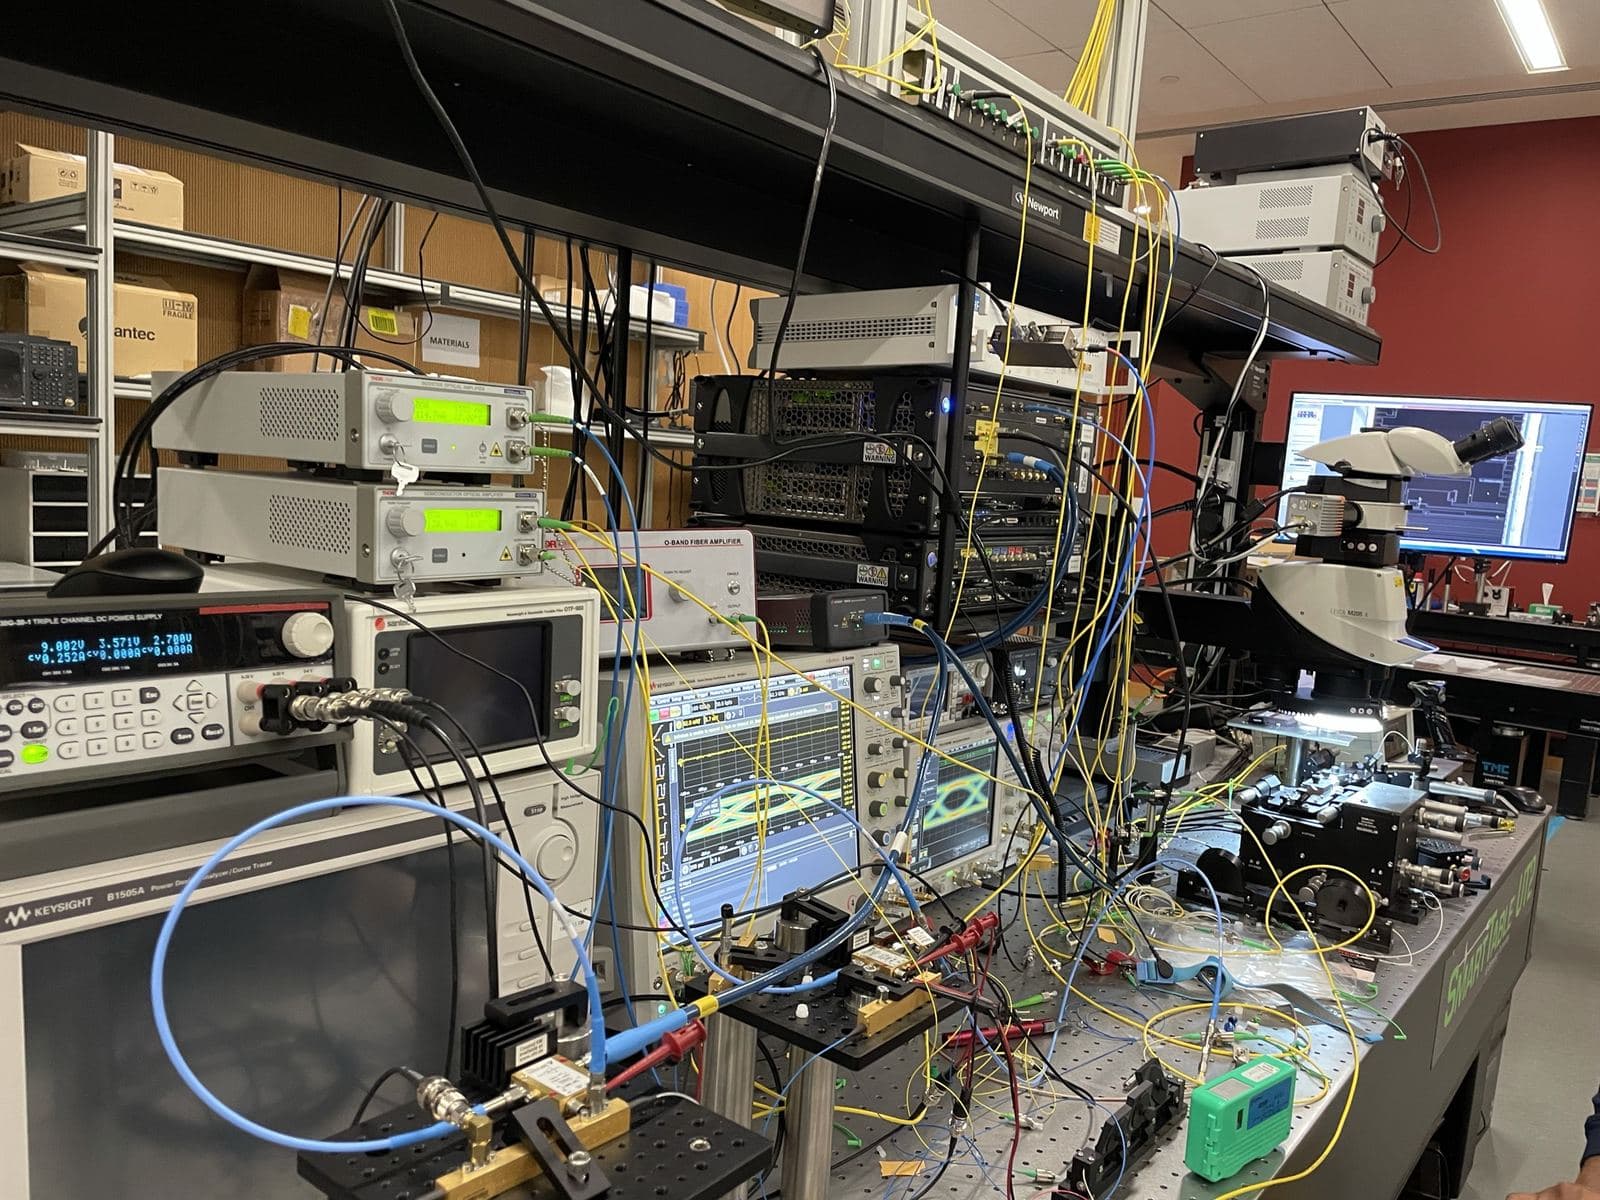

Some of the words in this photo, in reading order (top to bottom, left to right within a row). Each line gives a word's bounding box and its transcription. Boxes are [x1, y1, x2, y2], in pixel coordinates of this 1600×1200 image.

[1028, 197, 1059, 220] Newport
[163, 311, 193, 320] FRAGILE
[113, 326, 155, 341] antec
[430, 337, 470, 349] MATERIALS
[864, 454, 896, 463] WARNING
[858, 575, 889, 587] WARNING
[33, 617, 59, 625] TRIPLE
[60, 615, 95, 623] CHANNEL
[96, 615, 107, 623] DC
[99, 637, 140, 649] 3.571V
[1481, 761, 1510, 775] TMC
[34, 896, 94, 917] KEYSIGHT
[107, 886, 145, 902] B1505A
[151, 882, 174, 891] Power
[252, 861, 273, 870] Tracer
